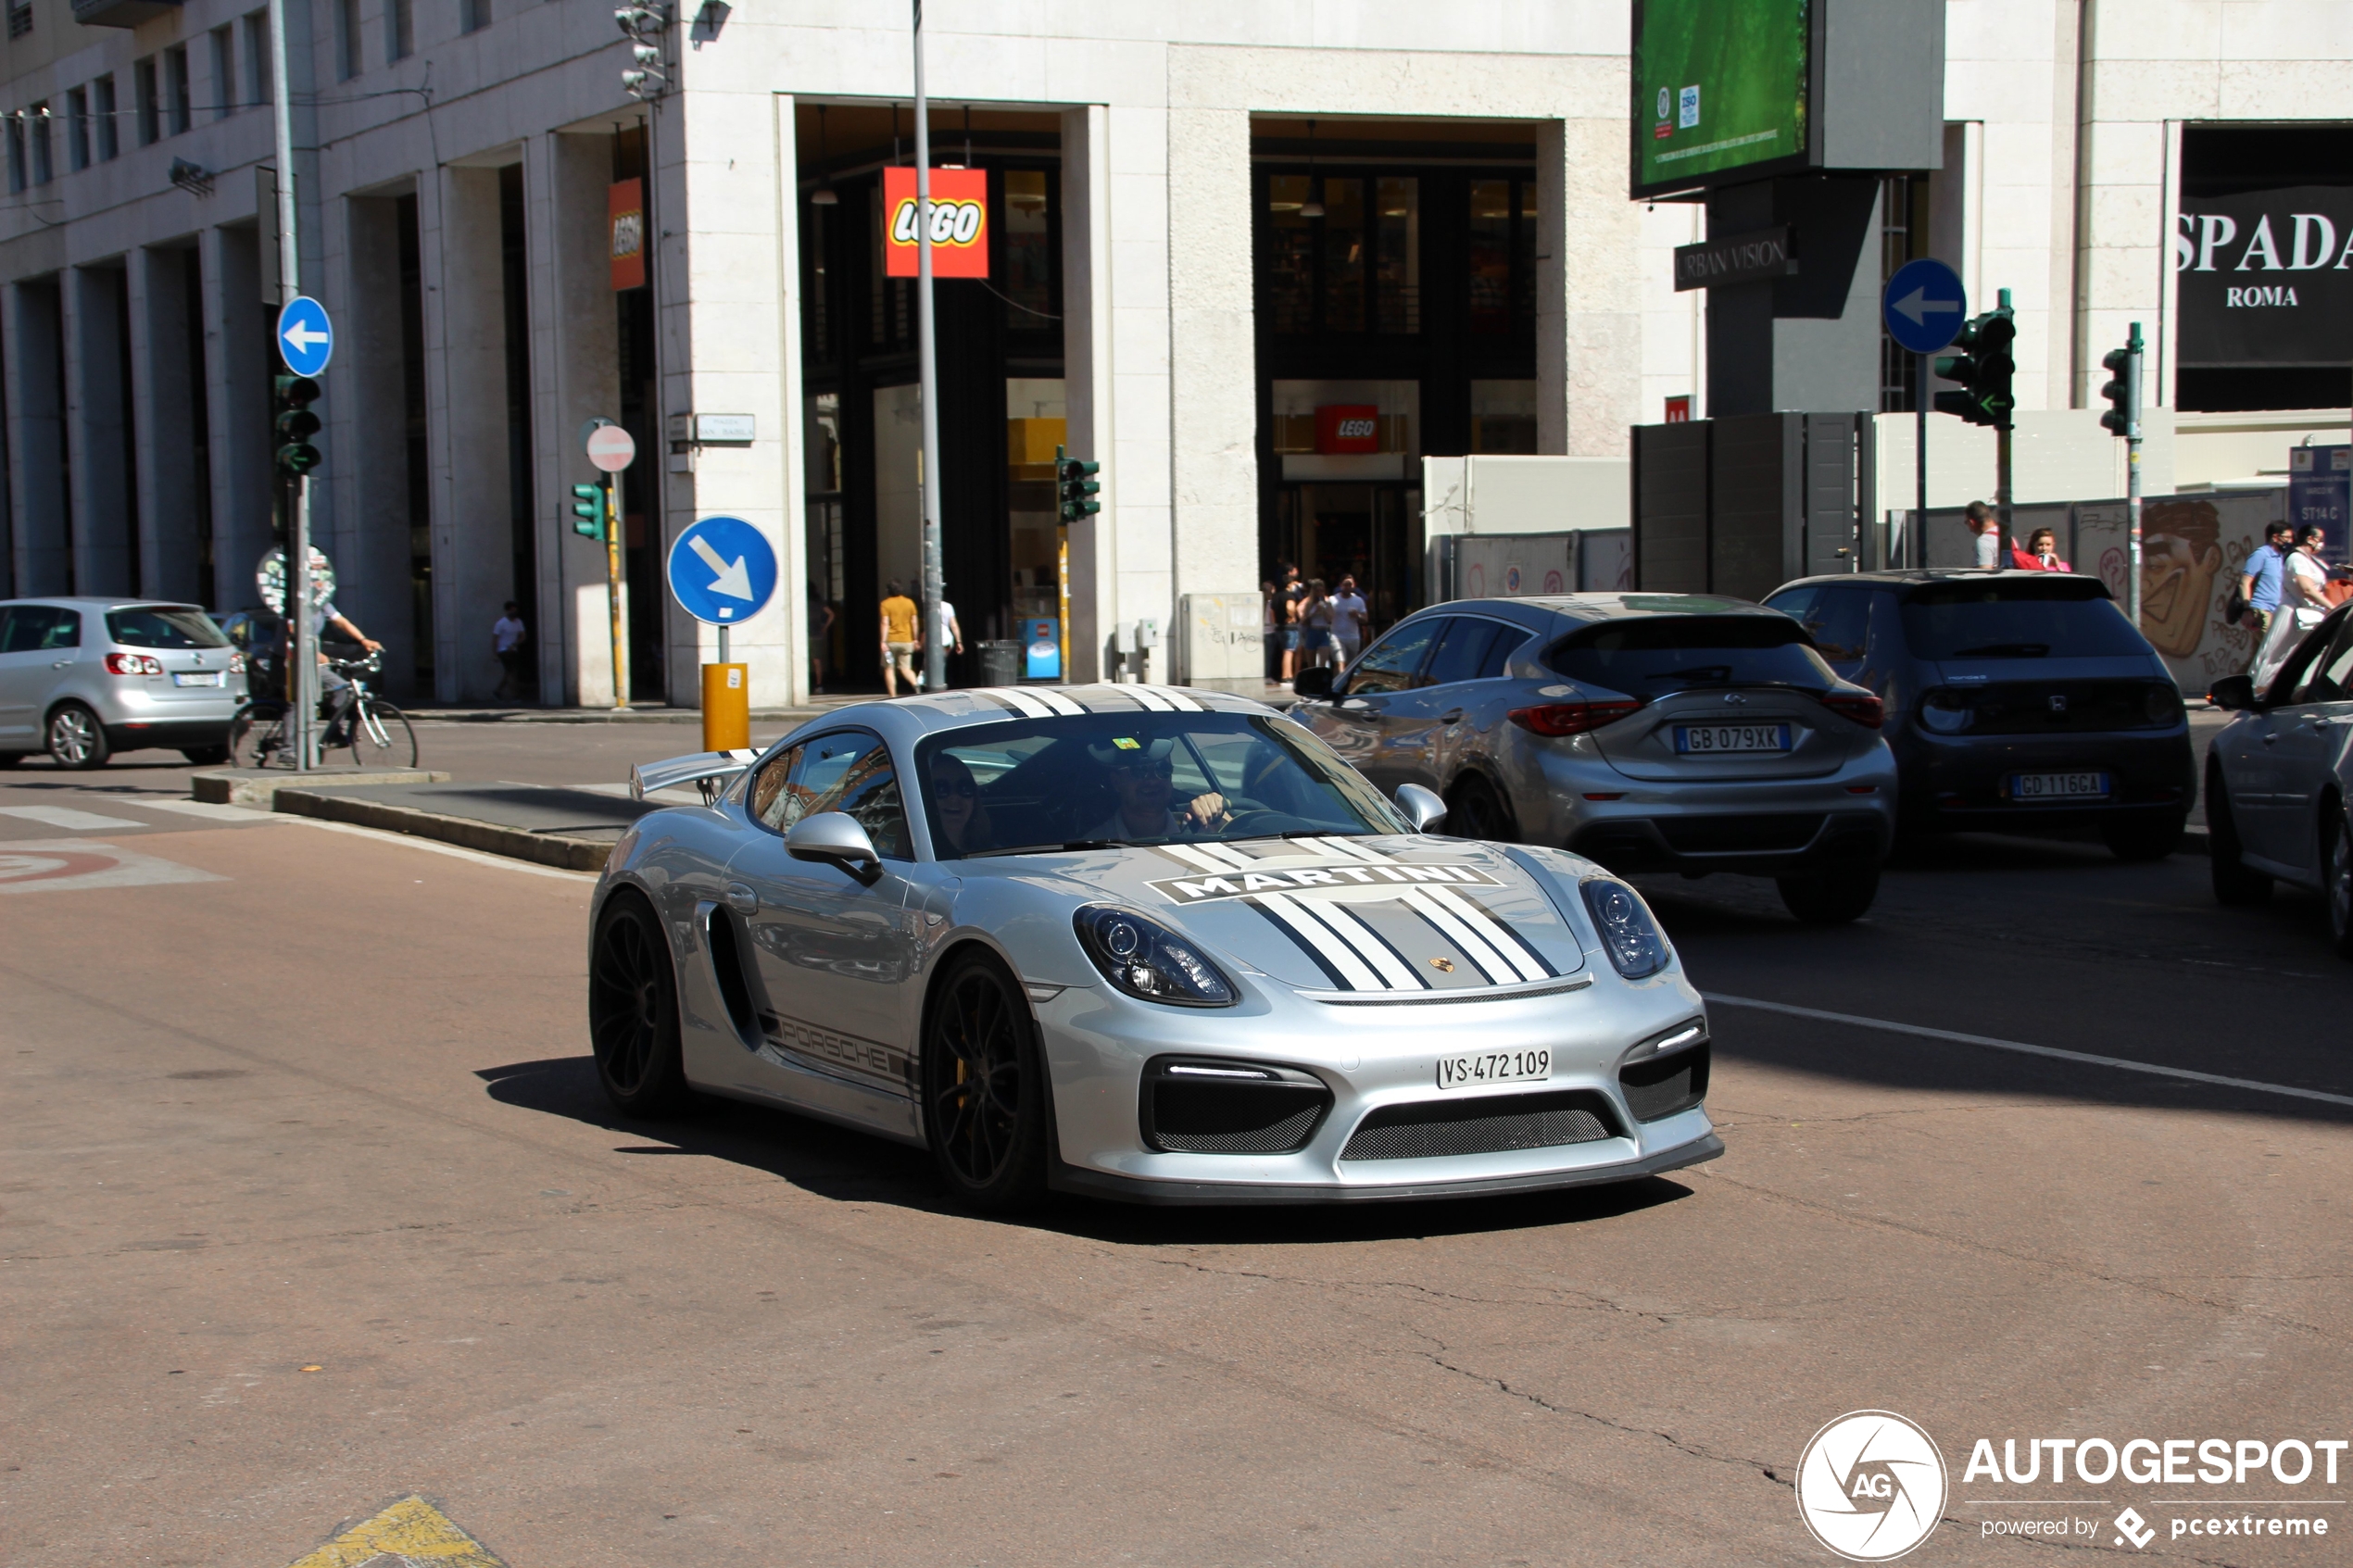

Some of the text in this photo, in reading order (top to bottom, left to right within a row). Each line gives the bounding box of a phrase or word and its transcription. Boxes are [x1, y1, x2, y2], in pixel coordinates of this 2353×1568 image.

[1681, 95, 1696, 107] ISO
[1677, 239, 1785, 281] URBAN VISION
[2226, 286, 2298, 307] ROMA
[1338, 420, 1374, 436] LEGO
[2302, 506, 2338, 521] ST14 C
[1171, 867, 1481, 898] MARTINI
[781, 1020, 888, 1072] PORSCHE
